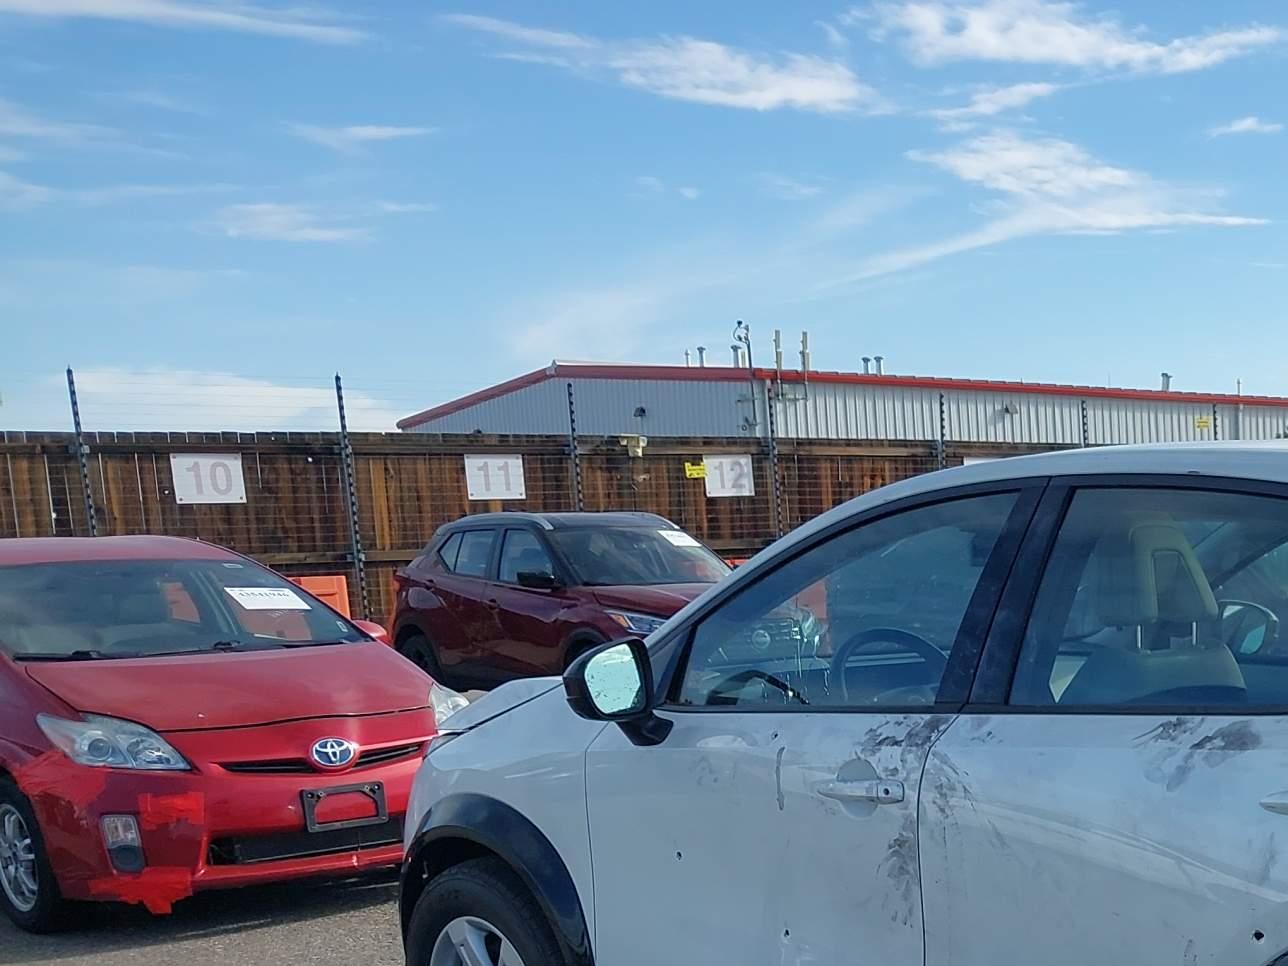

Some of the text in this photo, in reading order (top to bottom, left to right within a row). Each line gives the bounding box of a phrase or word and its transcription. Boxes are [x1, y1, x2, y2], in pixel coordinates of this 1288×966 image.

[185, 461, 233, 496] 10
[477, 461, 511, 491] 11
[714, 461, 746, 488] 12
